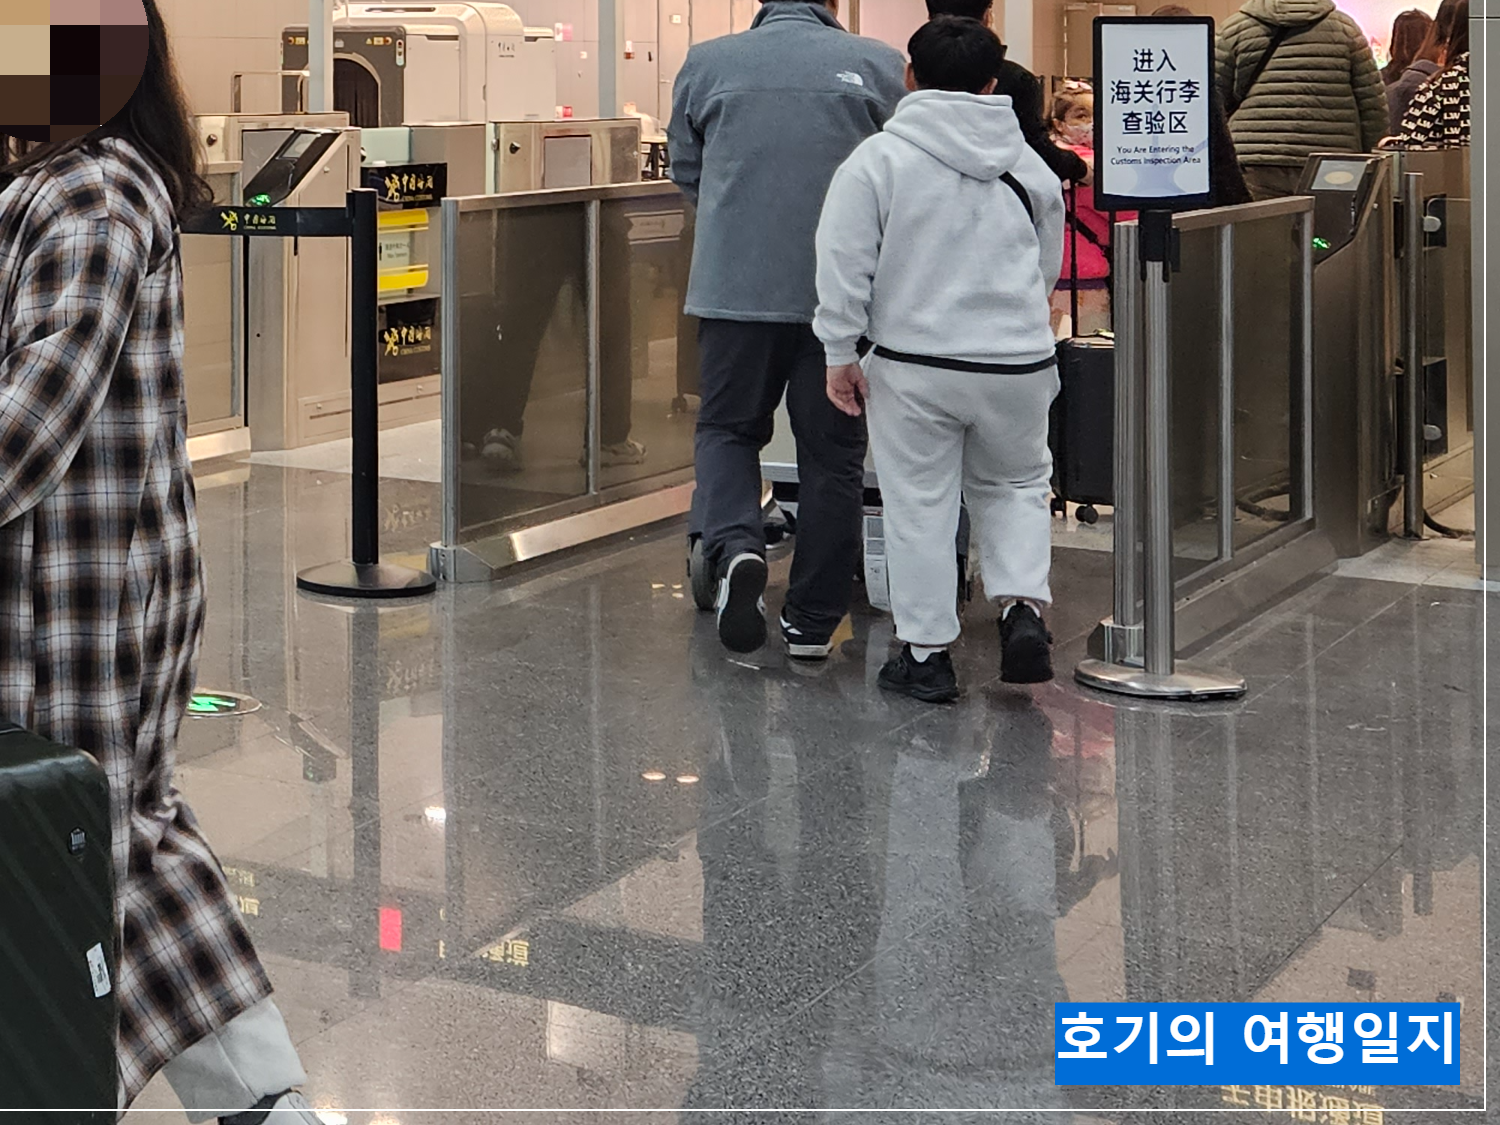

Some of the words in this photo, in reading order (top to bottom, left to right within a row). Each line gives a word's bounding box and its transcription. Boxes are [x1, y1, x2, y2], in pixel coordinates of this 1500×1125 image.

[1132, 48, 1177, 73] 进入
[1110, 79, 1200, 105] 海关行李
[1122, 110, 1188, 135] 查验区
[1110, 157, 1142, 165] Customs
[1143, 156, 1181, 166] Inspection
[1183, 156, 1201, 164] Area
[1116, 146, 1132, 154] You
[1133, 146, 1147, 154] Are
[1149, 145, 1180, 155] Entering
[1182, 145, 1195, 153] the
